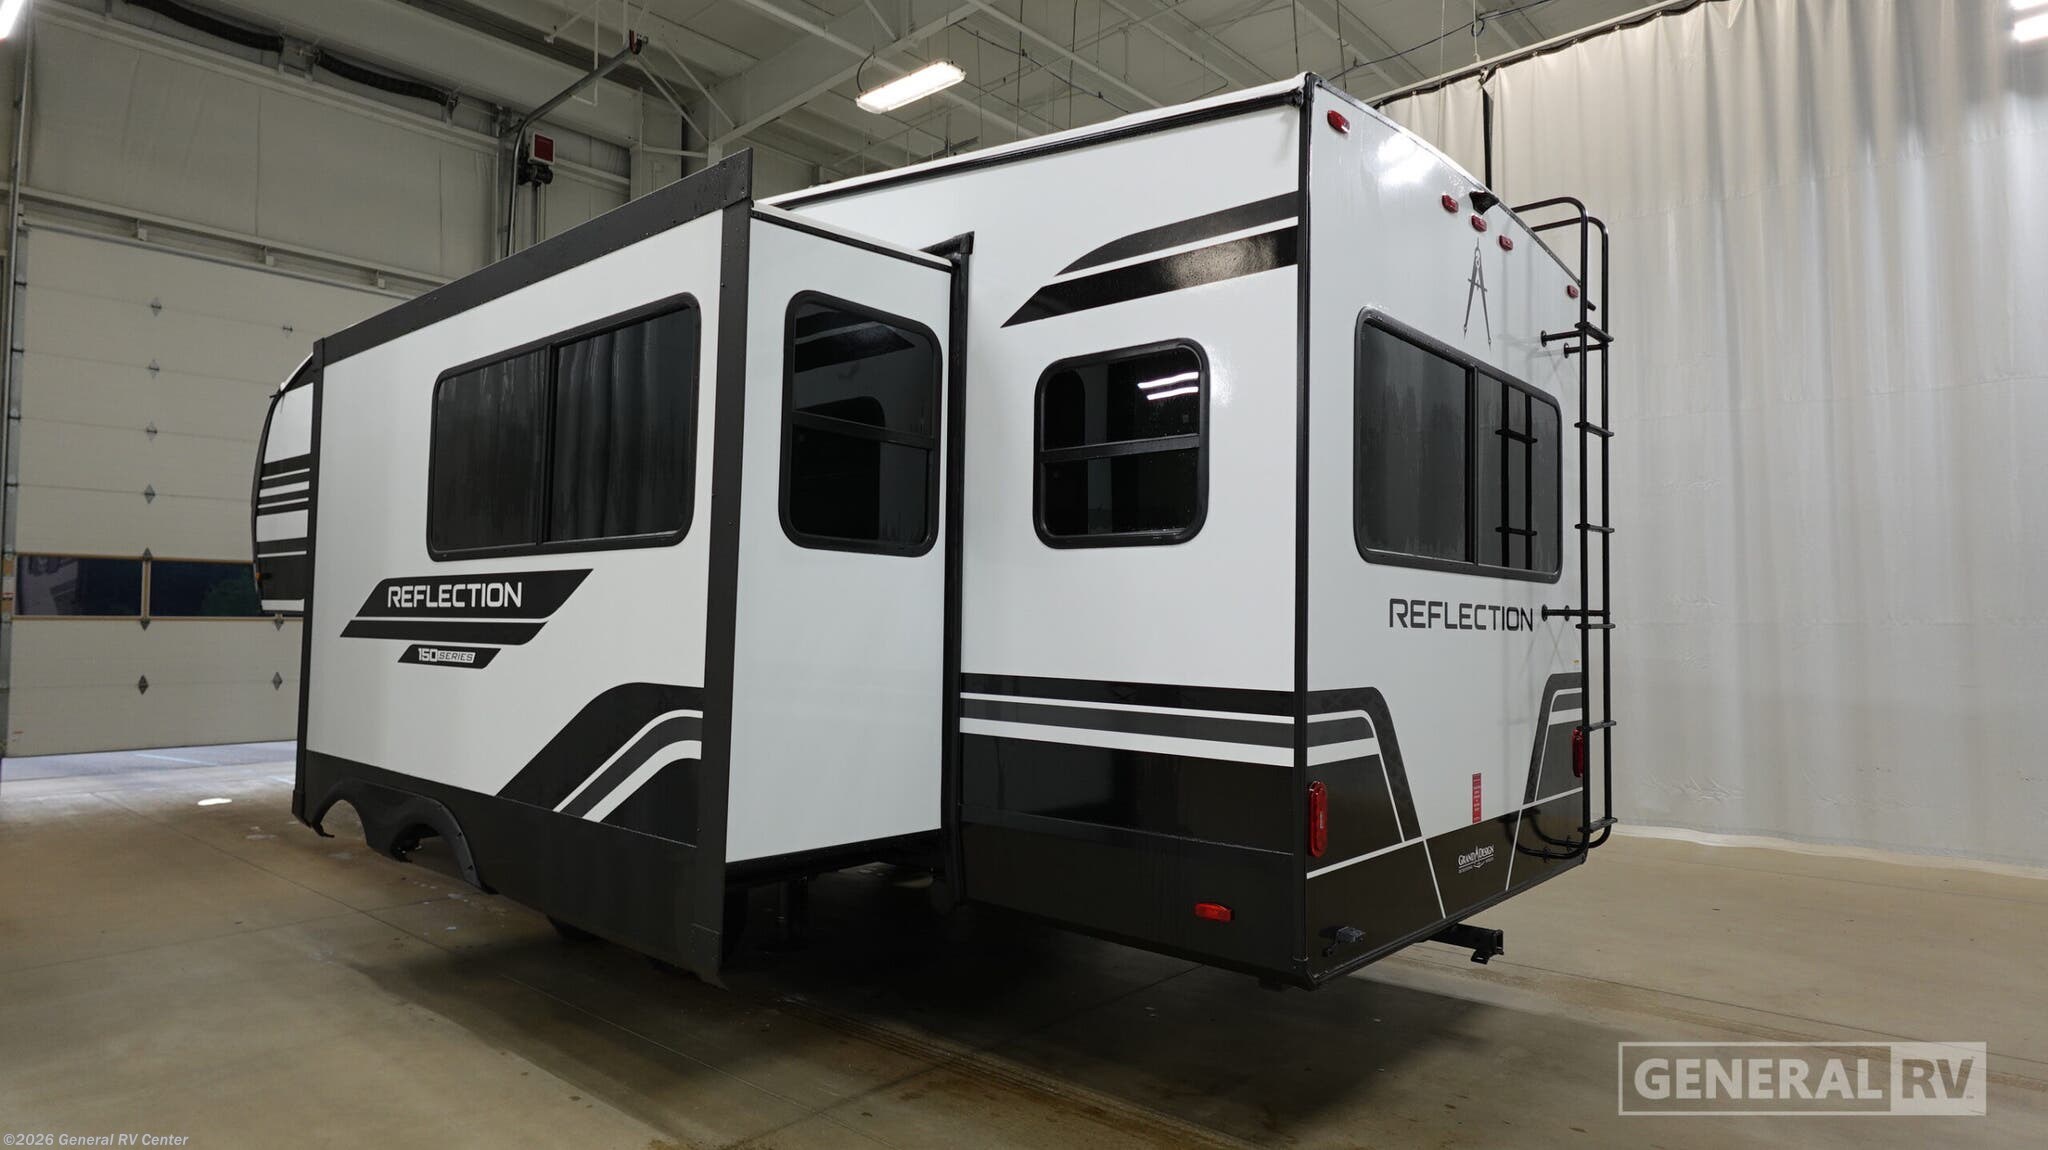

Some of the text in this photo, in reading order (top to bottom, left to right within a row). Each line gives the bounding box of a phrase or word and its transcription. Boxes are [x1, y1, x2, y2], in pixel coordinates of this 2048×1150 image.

[387, 582, 523, 608] REFLECTION
[1389, 598, 1534, 632] REFLECTION
[418, 647, 475, 663] 150 SERIES
